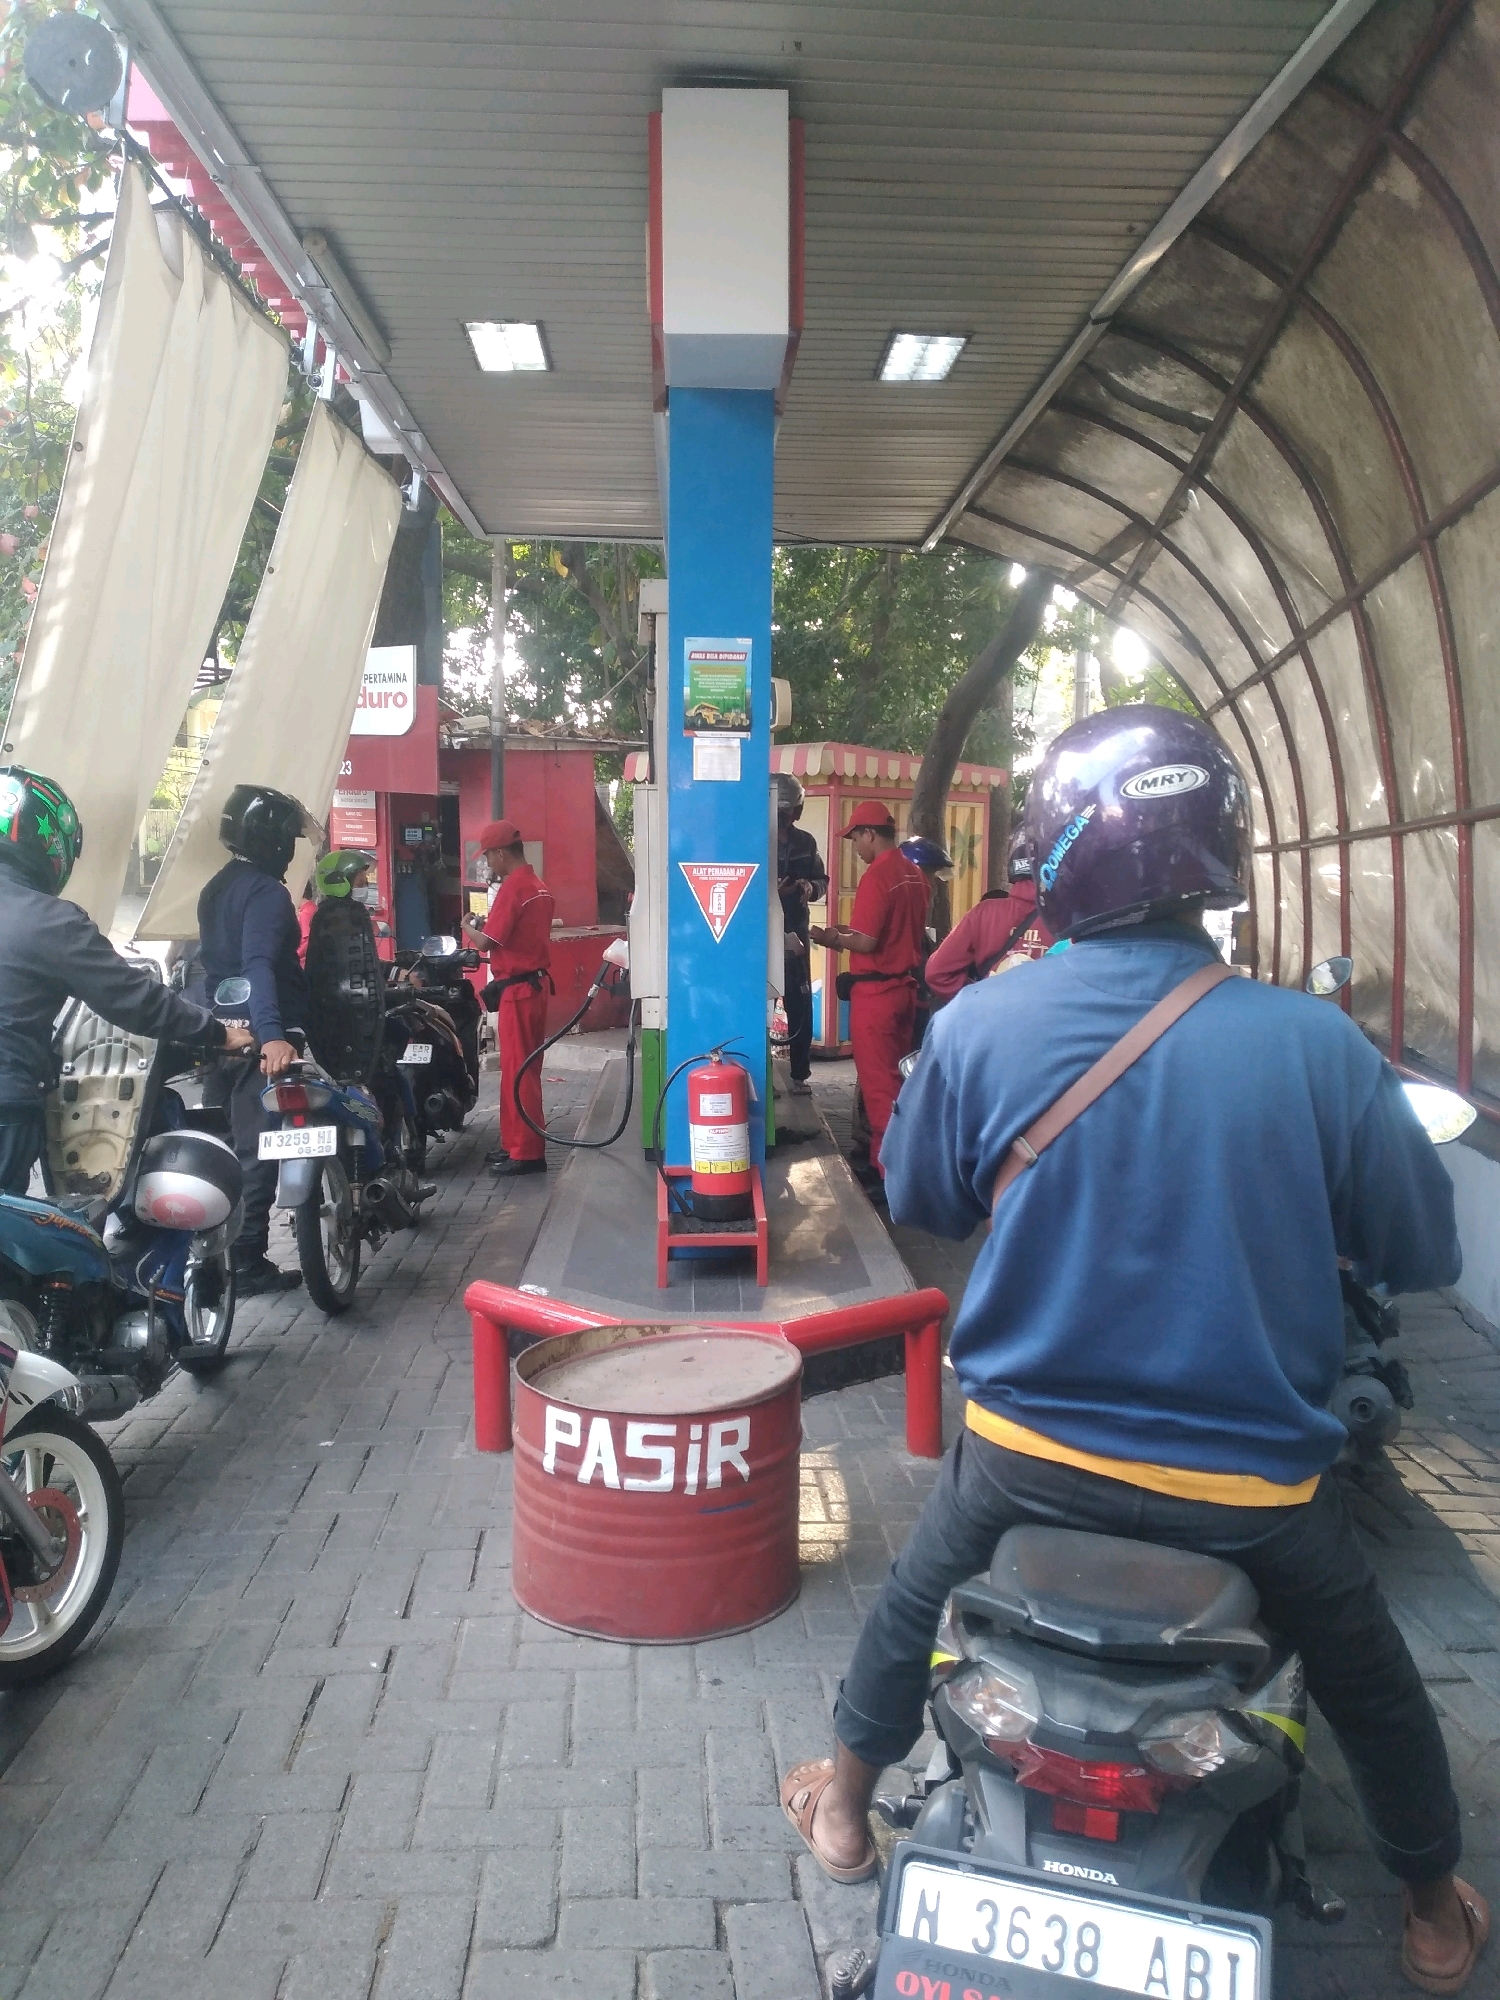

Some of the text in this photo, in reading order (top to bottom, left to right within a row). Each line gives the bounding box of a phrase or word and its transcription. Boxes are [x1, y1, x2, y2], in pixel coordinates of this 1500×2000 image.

[363, 672, 408, 685] PERTAMINA
[1140, 770, 1189, 791] MRY
[692, 867, 746, 877] ALAT PEMADAM API
[263, 1130, 332, 1149] N 3259 HI
[1043, 1859, 1119, 1886] HONDA
[972, 1898, 1101, 1980] 3638
[924, 1957, 1014, 1992] HONDA
